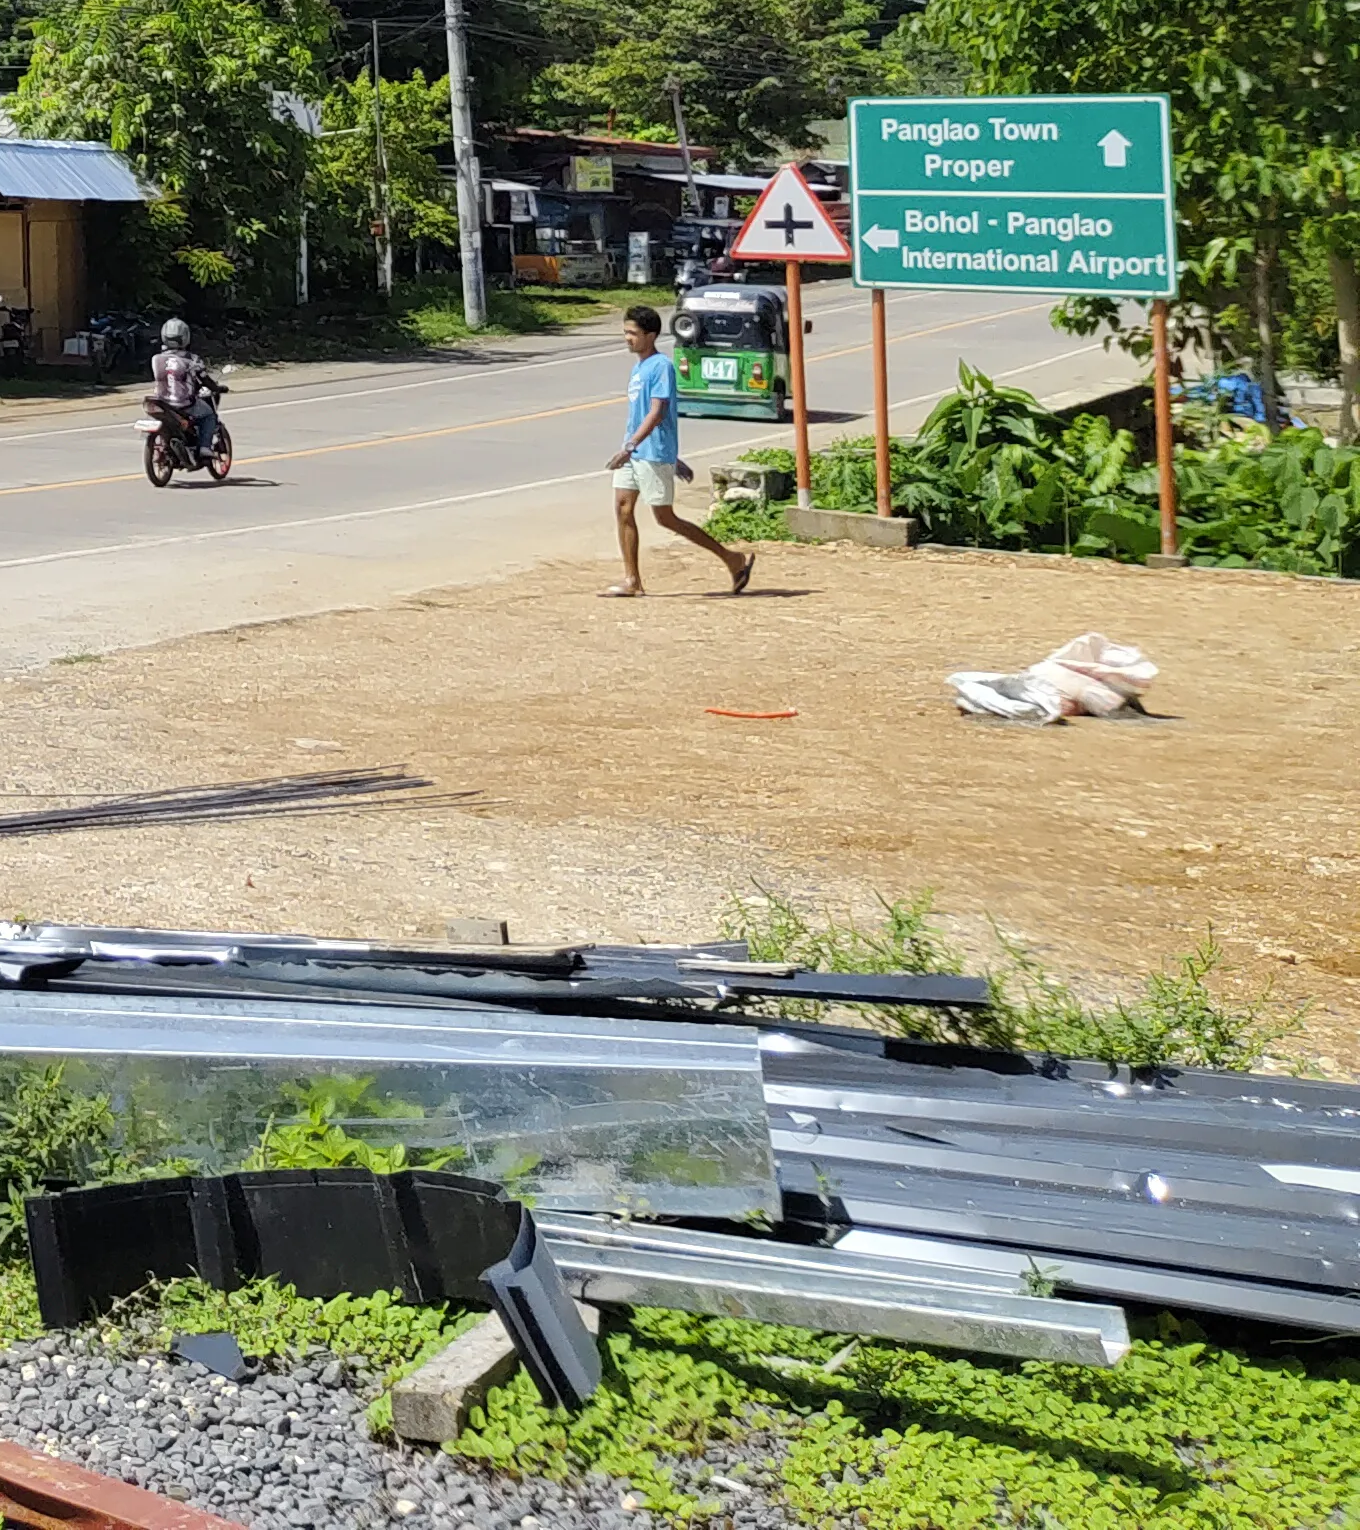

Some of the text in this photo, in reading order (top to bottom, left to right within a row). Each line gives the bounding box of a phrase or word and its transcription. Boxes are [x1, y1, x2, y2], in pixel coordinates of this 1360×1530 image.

[881, 118, 1058, 146] Panglao Town
[924, 154, 1015, 182] Proper
[904, 210, 979, 233] Bohol
[1007, 212, 1113, 242] Panglao
[902, 246, 1166, 280] International Airport
[703, 360, 735, 378] 047
